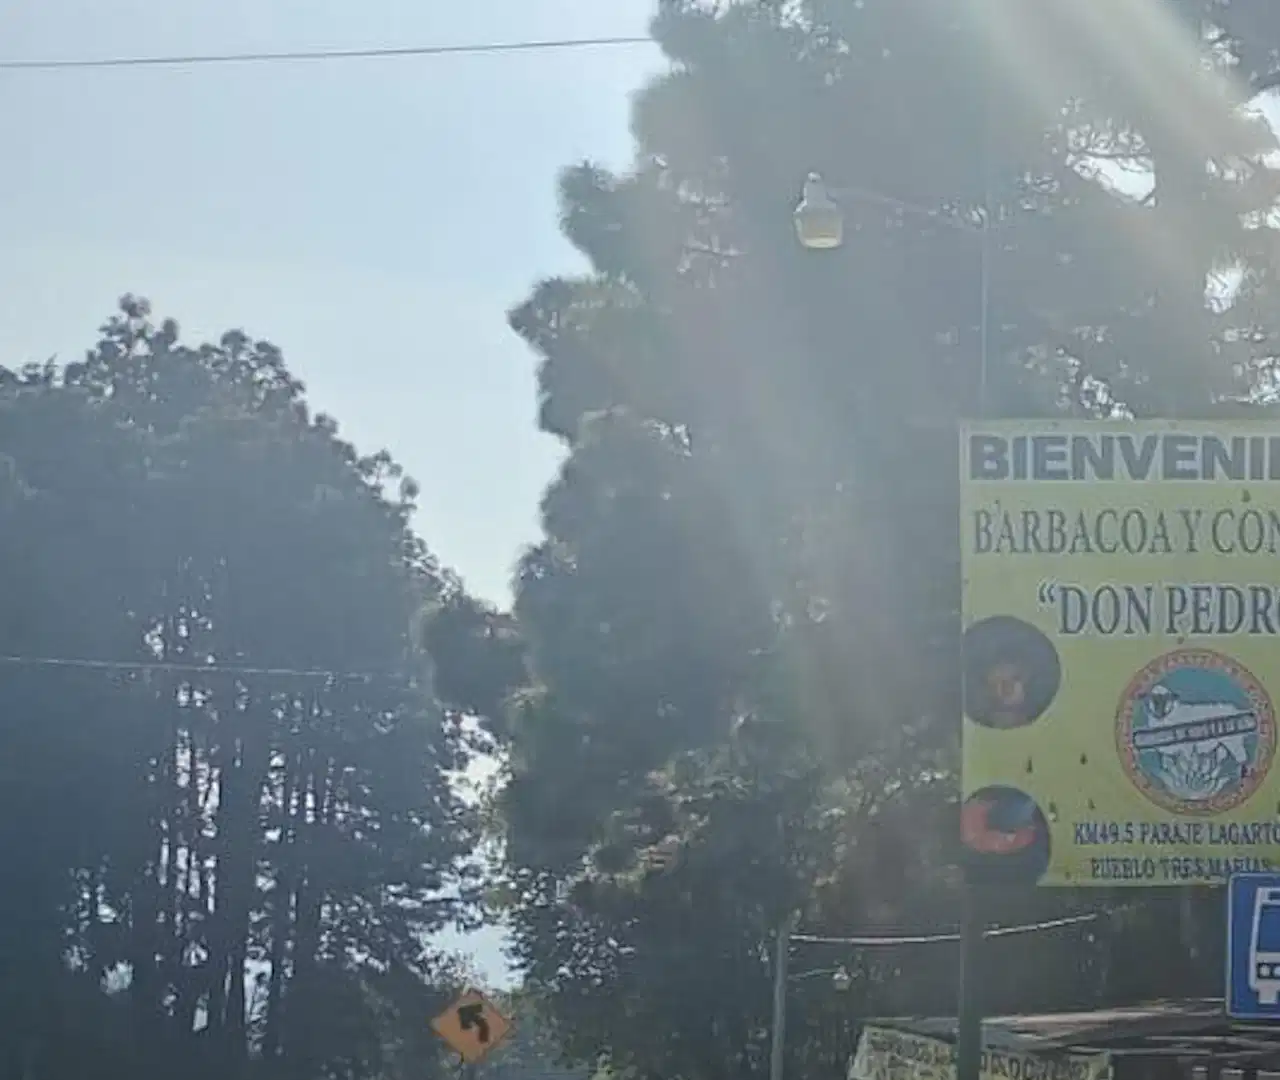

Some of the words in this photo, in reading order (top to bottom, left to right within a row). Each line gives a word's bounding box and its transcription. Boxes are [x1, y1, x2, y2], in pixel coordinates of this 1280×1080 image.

[973, 508, 1174, 555] BARBACOA
[1177, 509, 1201, 554] Y
[1038, 582, 1155, 636] “DON
[1140, 822, 1201, 845] PARAJE
[1091, 857, 1155, 880] PUEBLO
